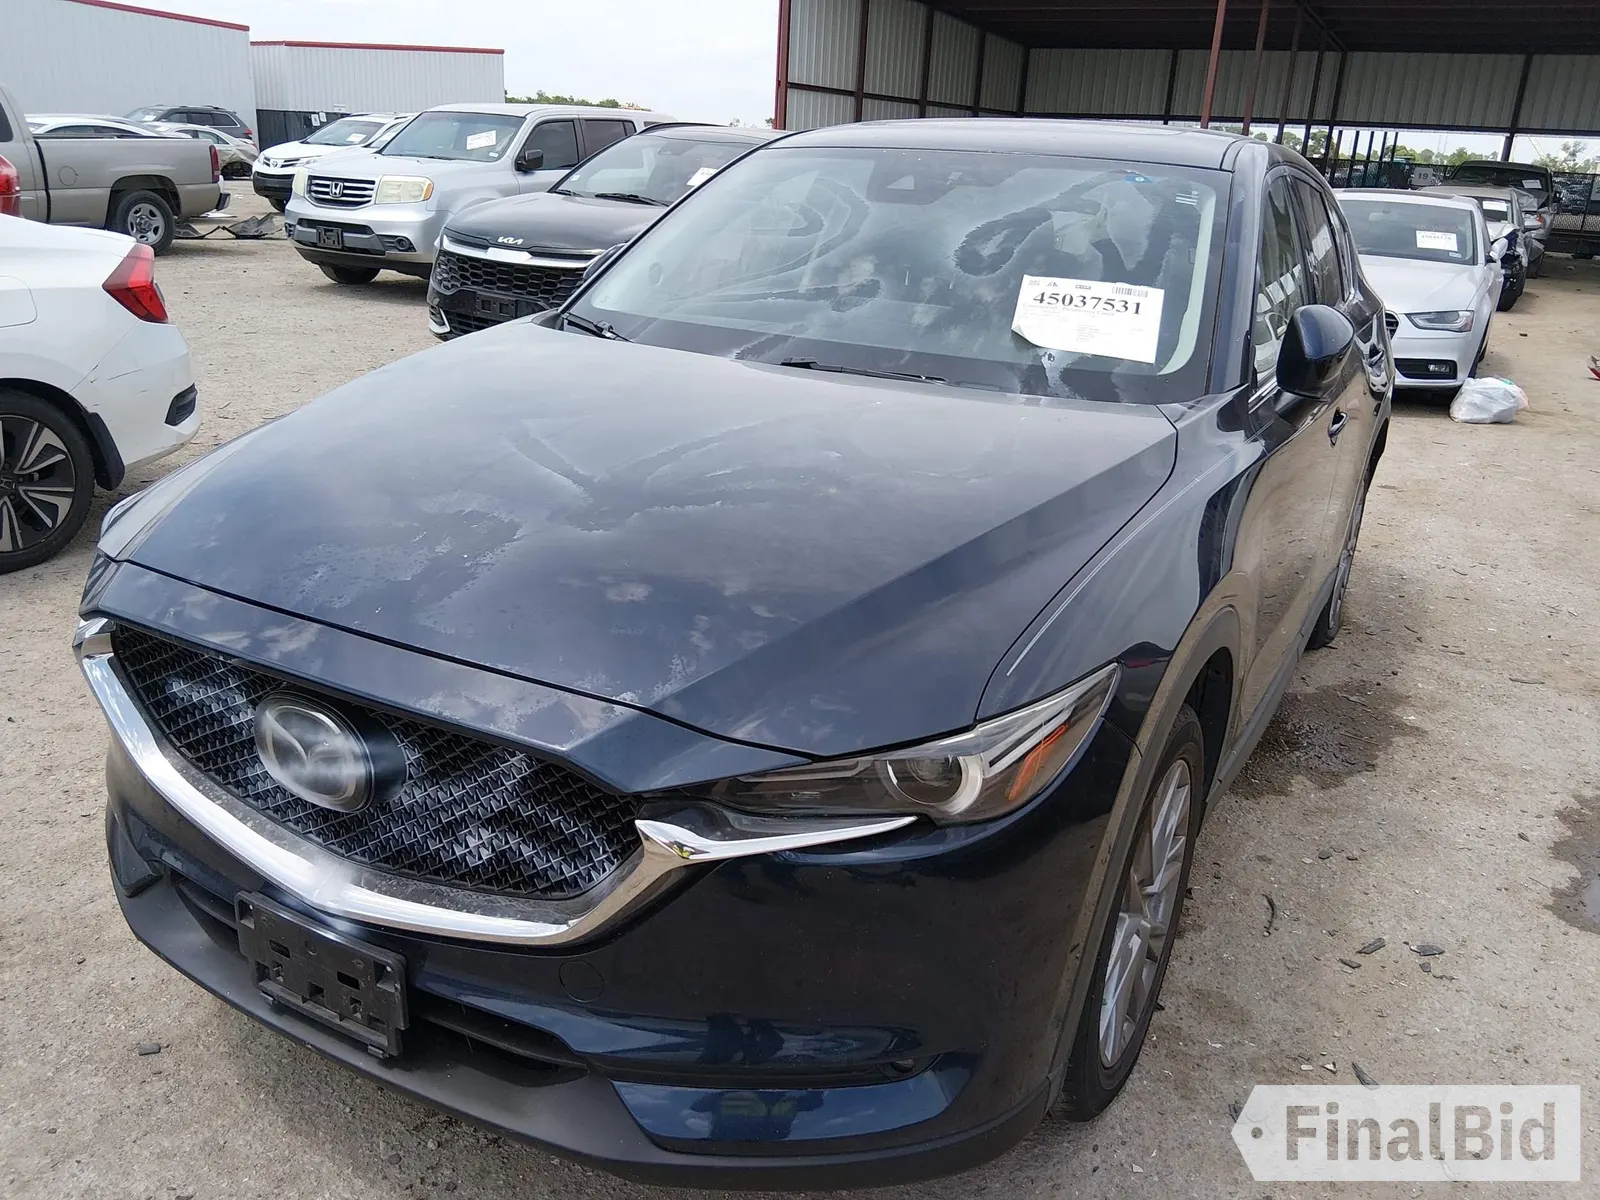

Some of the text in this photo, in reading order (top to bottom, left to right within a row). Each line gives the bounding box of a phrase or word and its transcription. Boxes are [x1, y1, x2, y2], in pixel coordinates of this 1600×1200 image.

[1418, 172, 1429, 180] 19
[497, 236, 524, 245] KIA
[1033, 291, 1141, 315] 45037531
